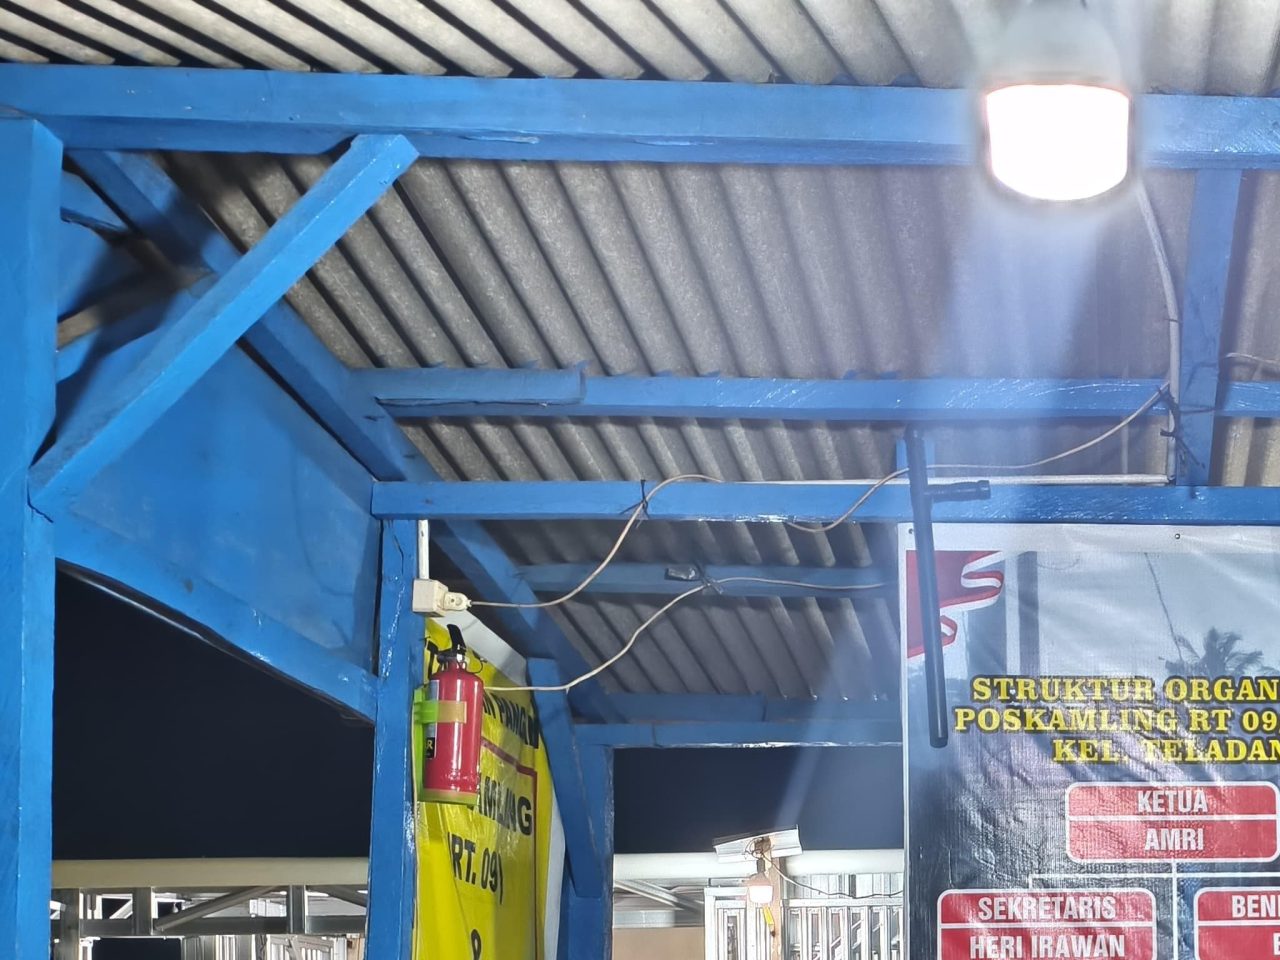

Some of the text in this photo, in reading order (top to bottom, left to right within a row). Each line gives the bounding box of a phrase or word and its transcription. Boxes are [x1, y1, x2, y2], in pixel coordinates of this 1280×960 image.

[973, 678, 1155, 701] STRUKTUR
[954, 709, 1178, 733] POSKAMLING
[1188, 709, 1231, 732] RT
[1053, 739, 1129, 763] KEL.
[1138, 791, 1209, 812] KETUA
[1145, 829, 1205, 851] AMRI
[978, 896, 1116, 920] SEKRETARIS
[970, 935, 1125, 959] HERI IRAWAN
